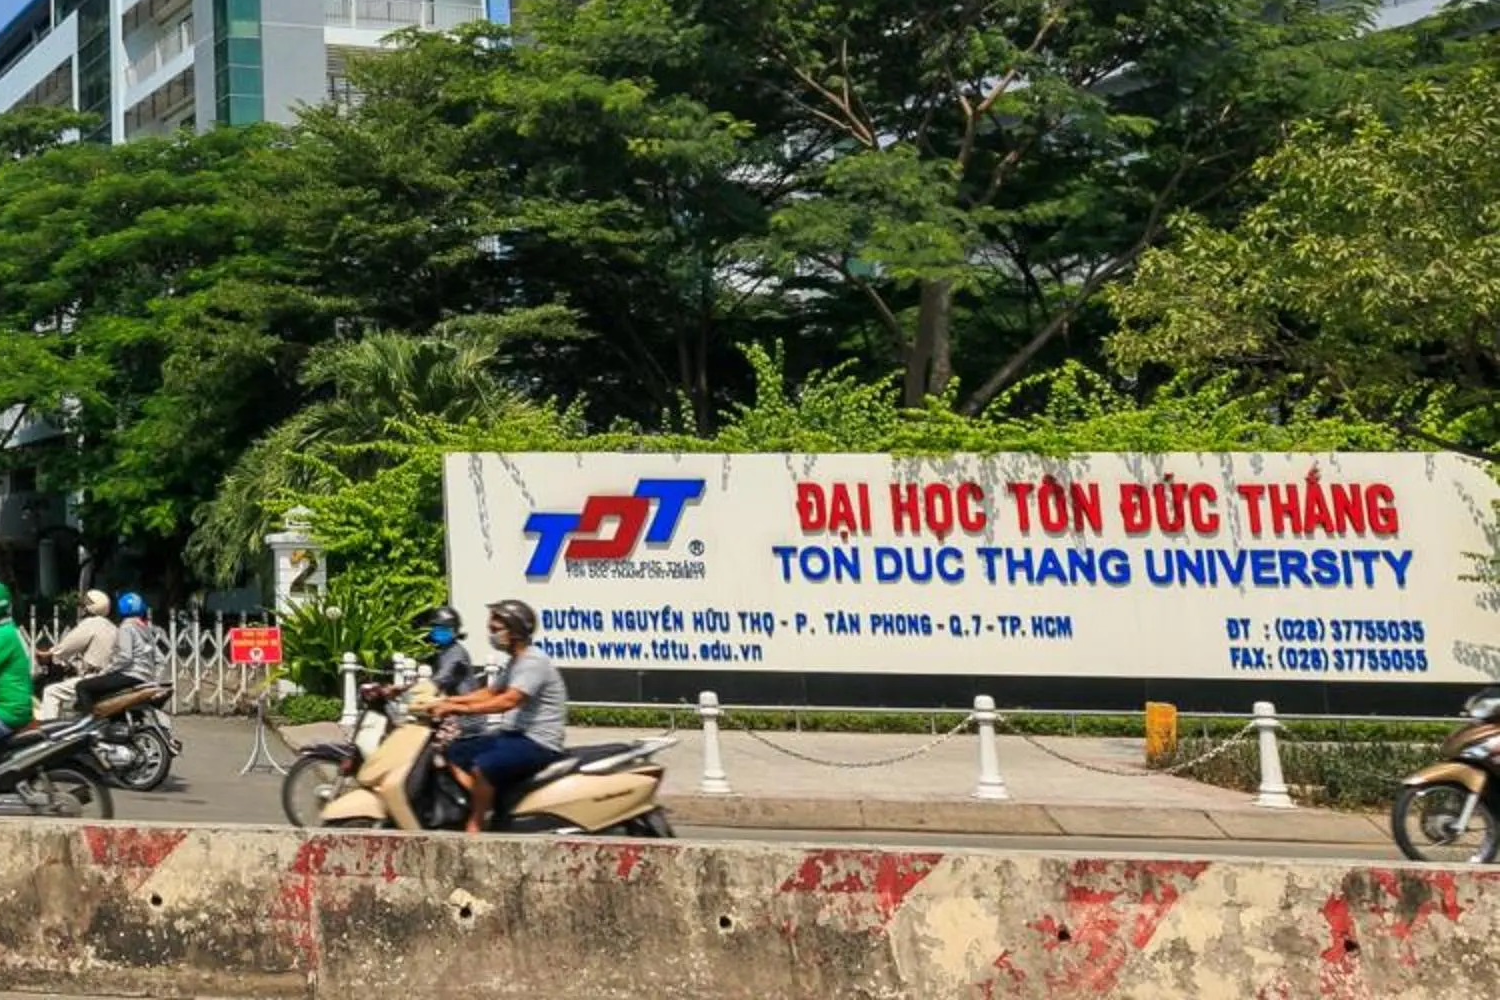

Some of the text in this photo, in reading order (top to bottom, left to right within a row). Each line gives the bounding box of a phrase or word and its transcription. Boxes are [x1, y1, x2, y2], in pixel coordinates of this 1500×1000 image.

[796, 466, 1400, 544] ĐẠI HỌC TÔN ĐỨC THẮNG
[290, 548, 318, 594] 2
[771, 546, 1413, 588] TON DUC THANG UNIVERSITY
[541, 605, 603, 632] ĐƯỜNG
[737, 611, 775, 639] THỌ
[795, 612, 816, 636] P.
[824, 609, 861, 636] TÂN
[869, 612, 933, 637] PHONG
[1031, 615, 1073, 640] HCM
[1275, 617, 1325, 641] (028)
[1329, 619, 1425, 642] 37755035
[1229, 646, 1428, 672] FAX: (028) 37755055
